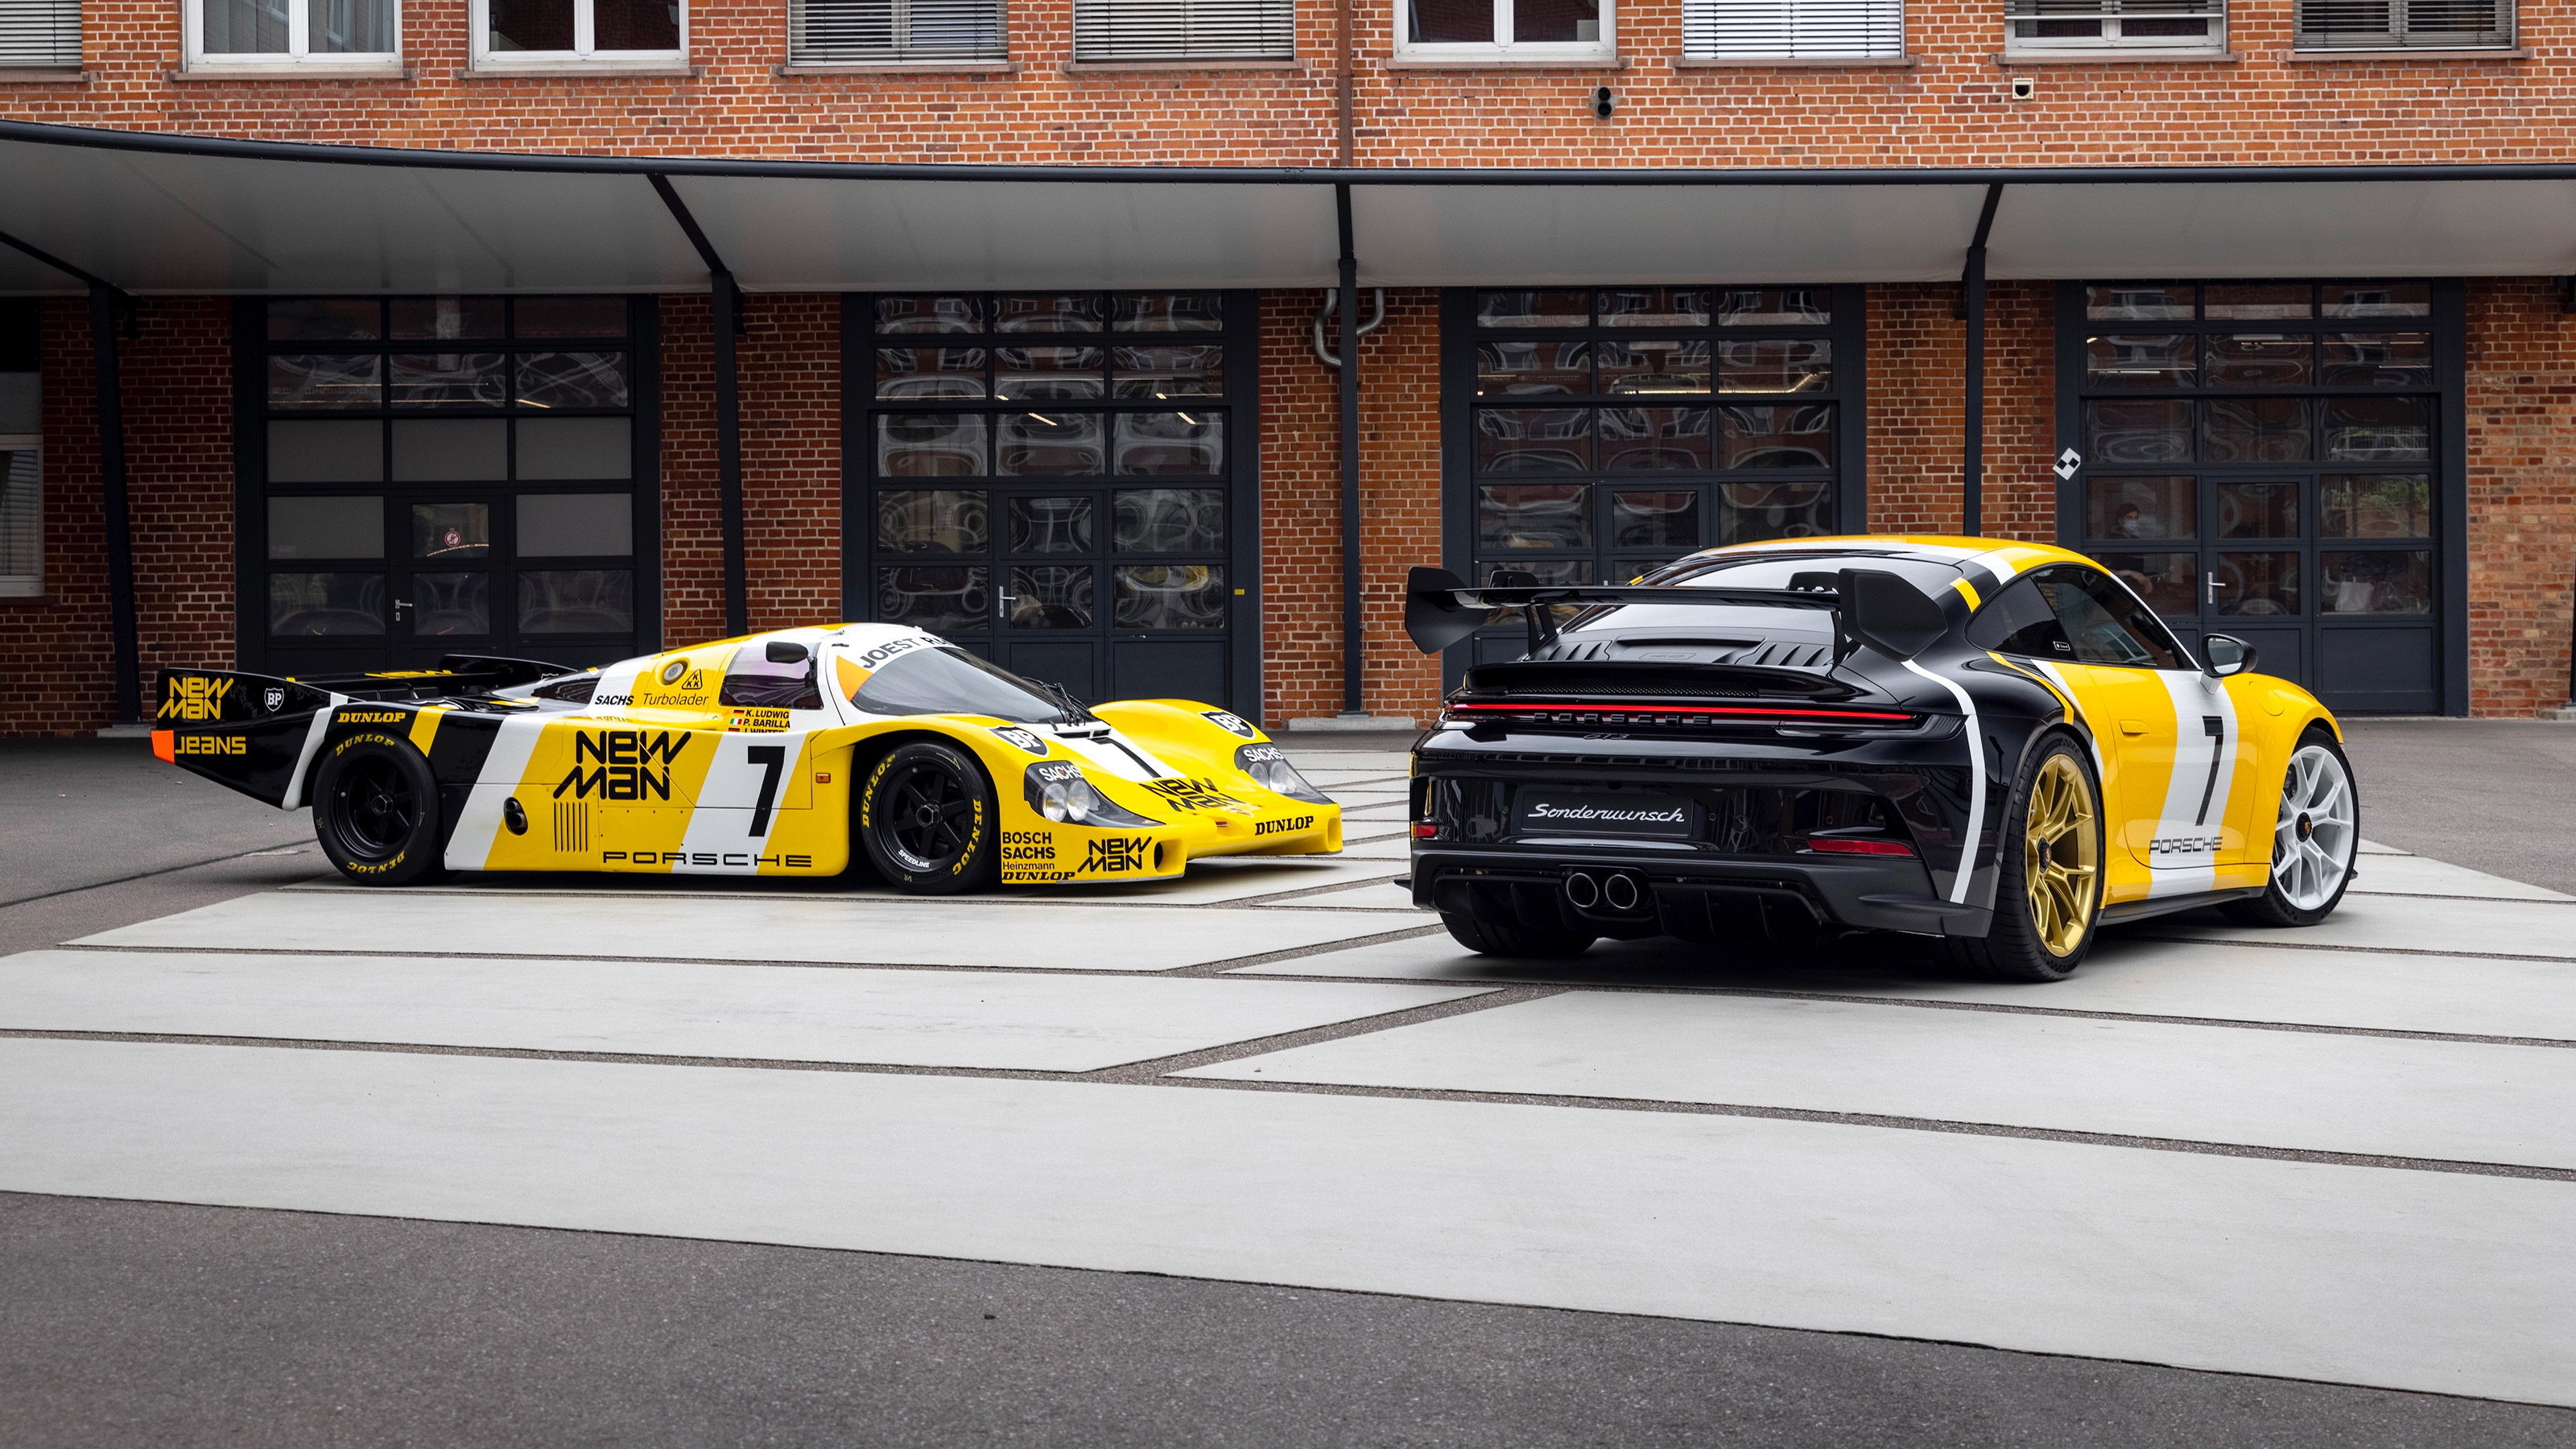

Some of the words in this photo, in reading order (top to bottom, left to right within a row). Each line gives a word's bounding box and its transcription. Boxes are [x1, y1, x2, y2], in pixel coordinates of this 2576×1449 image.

[860, 638, 921, 669] JOEST
[267, 692, 282, 706] BP
[595, 696, 634, 705] SACHS
[643, 693, 709, 705] Turbolader
[337, 712, 406, 723] DUNLOP
[755, 711, 790, 719] LUDWIG
[1209, 714, 1248, 732] BP
[1534, 712, 1712, 724] PORSCHE
[753, 719, 791, 729] BARILLA
[335, 734, 395, 756] DUNLOP
[998, 729, 1041, 749] BP
[1244, 748, 1284, 762] SACHS
[1038, 765, 1084, 782] SACHS
[2195, 715, 2223, 826] 7
[747, 745, 786, 837] 7
[862, 753, 896, 828] DUNLOP
[1528, 803, 1685, 823] Sonderwunsch
[1255, 815, 1314, 836] DUNLOP
[952, 799, 983, 876] DENLOC
[1002, 832, 1052, 844] BOSCH
[2149, 836, 2223, 854] PORSCHE
[603, 851, 812, 868] PORSCHE
[898, 848, 930, 869] SPEEDLINE
[1002, 846, 1055, 860] SACHS
[347, 851, 405, 874] DENLOC
[1002, 861, 1055, 870] Heinzmann
[1001, 872, 1075, 880] DUNLOP
